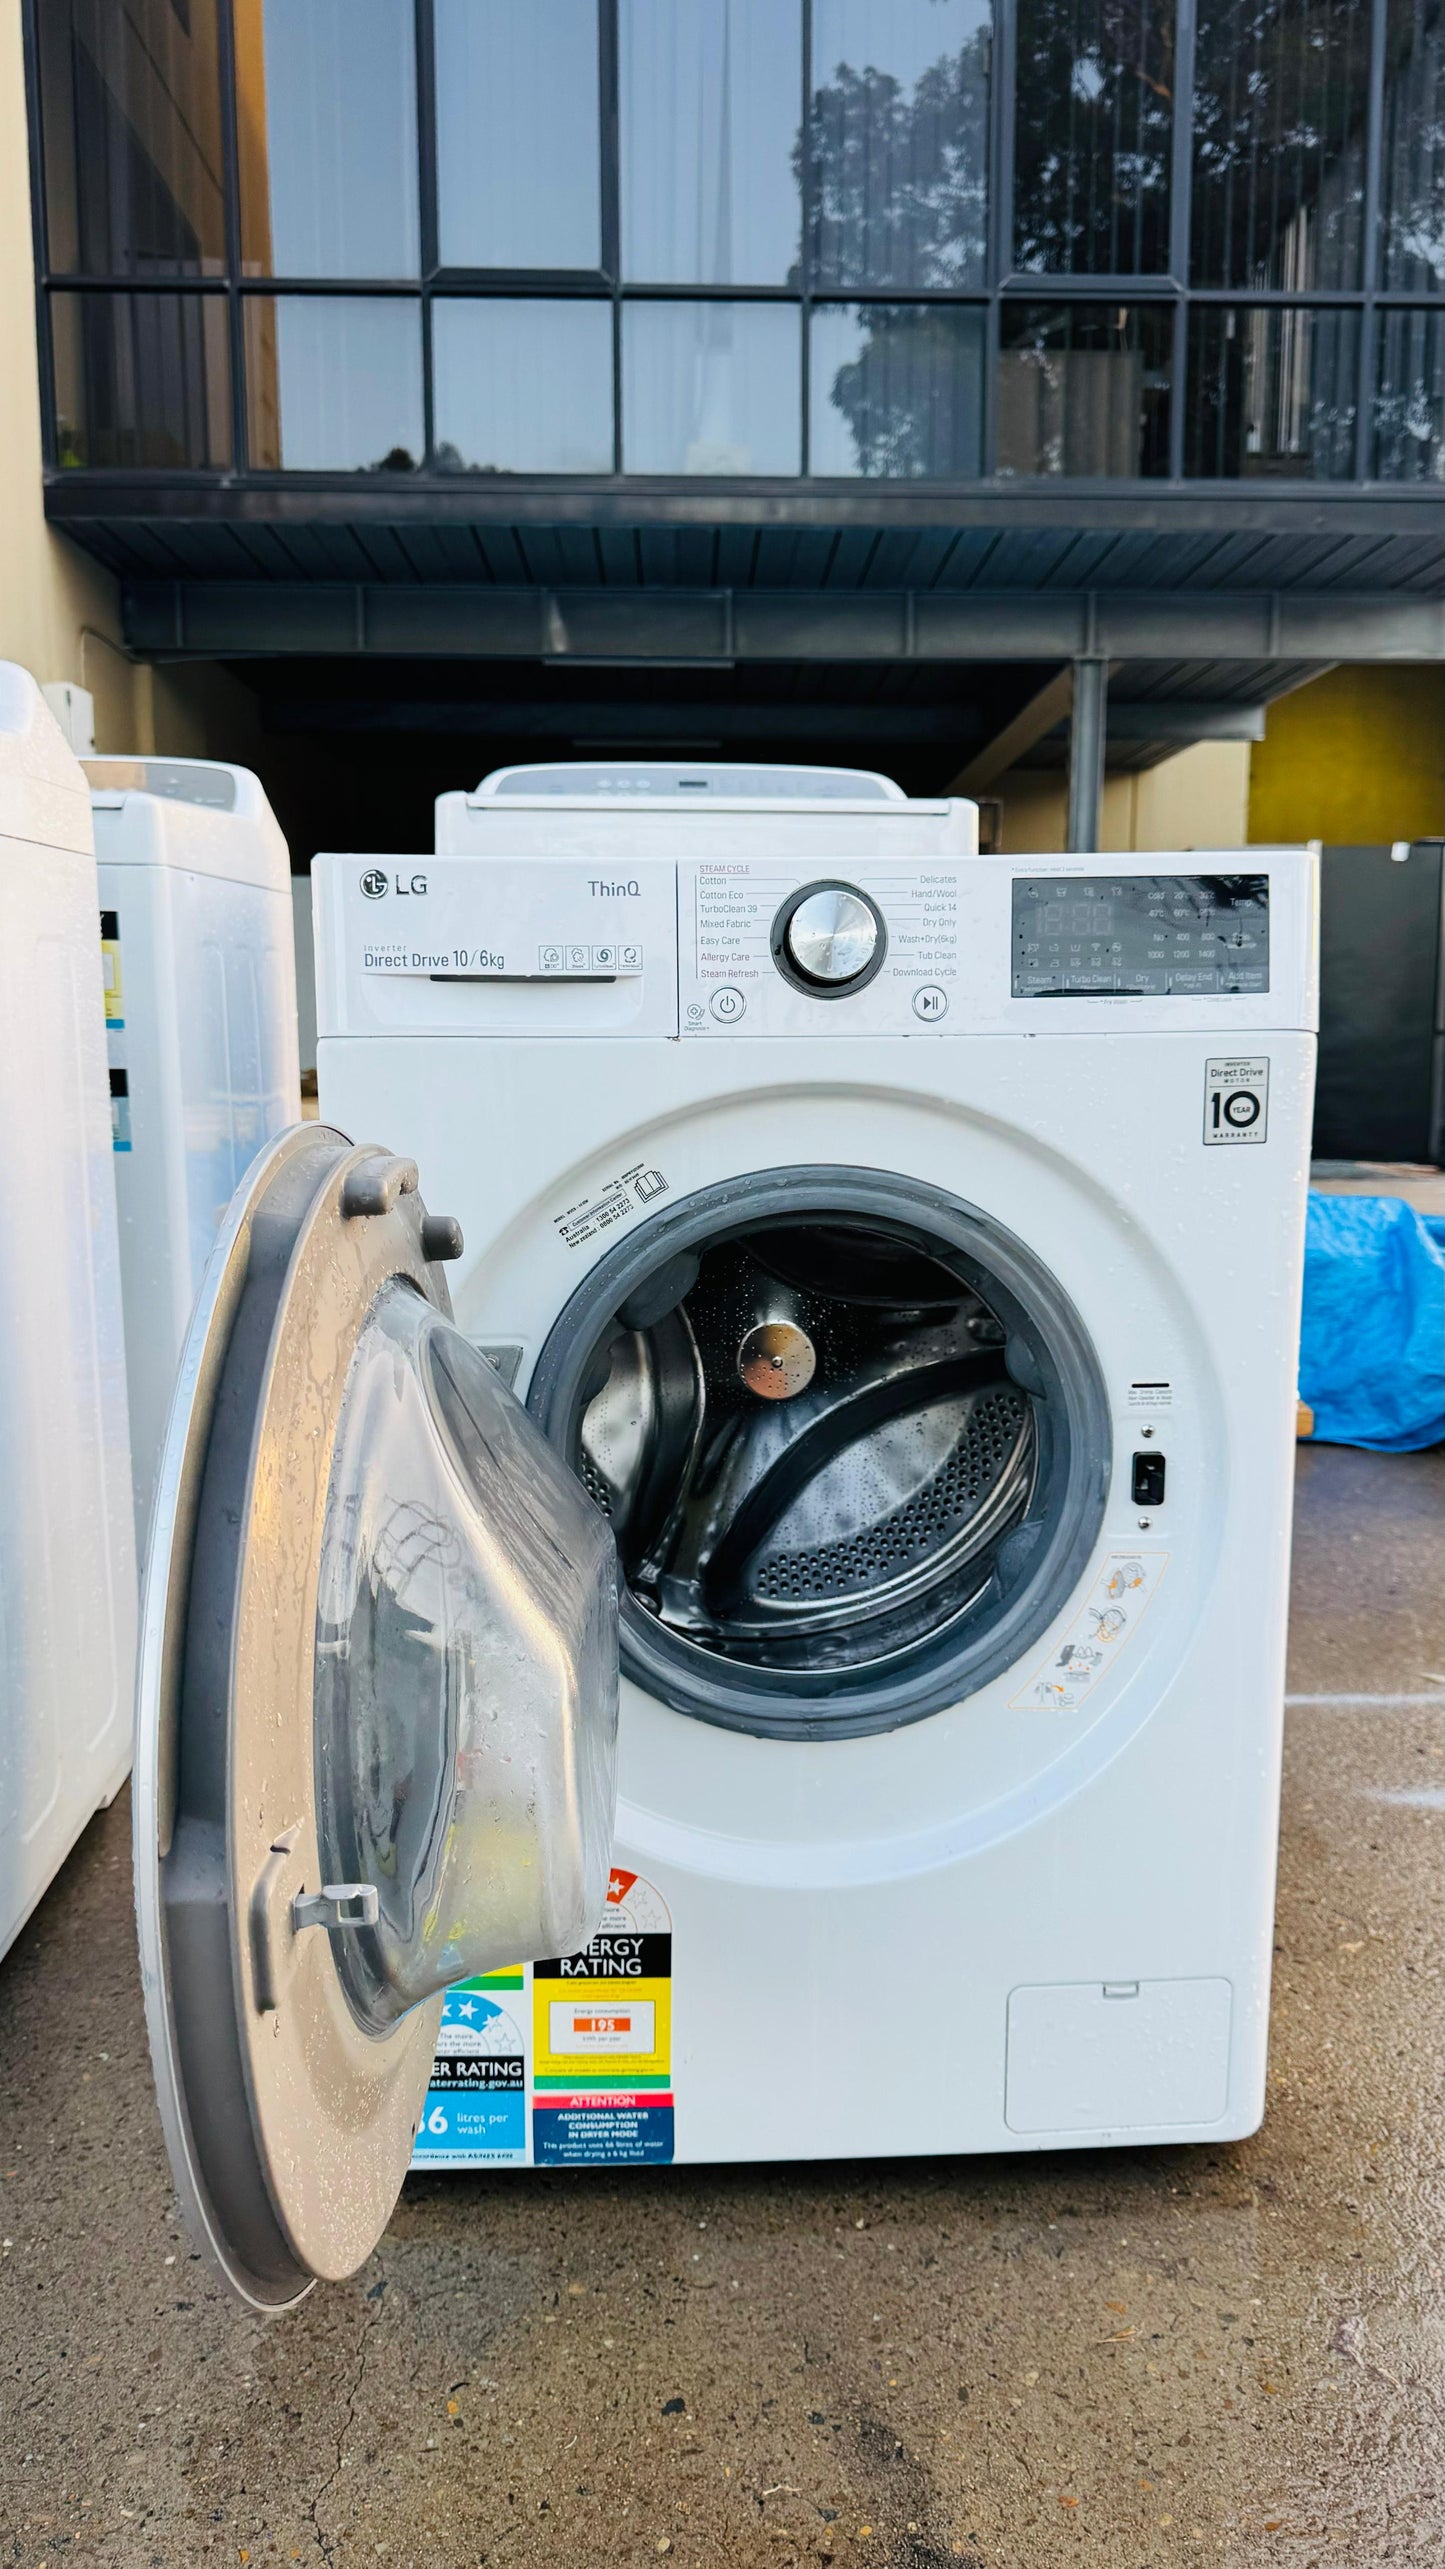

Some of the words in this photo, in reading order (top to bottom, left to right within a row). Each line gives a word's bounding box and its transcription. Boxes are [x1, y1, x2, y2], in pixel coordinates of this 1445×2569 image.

[699, 865, 726, 873] STEAM
[727, 865, 750, 873] CYCLE
[699, 876, 727, 885] Cotton
[920, 875, 957, 884] Delicates
[395, 874, 428, 895] LG
[588, 880, 641, 897] ThinQ
[700, 891, 727, 899] Cotton
[729, 891, 744, 899] Eco
[911, 890, 957, 898] Hand/Wool
[700, 905, 746, 913] TurboClean
[747, 905, 758, 913] 39
[924, 903, 947, 912] Quick
[948, 903, 957, 911] 14
[700, 920, 725, 928] Mixed
[726, 920, 751, 928] Fabric
[922, 918, 937, 927] Dry
[939, 918, 957, 928] Only
[701, 936, 720, 946] Easy
[721, 936, 740, 945] Care
[898, 935, 958, 944] Wash+Dry(6kg)
[364, 944, 407, 952] Inverter
[364, 953, 408, 967] Direct
[412, 953, 449, 967] Drive
[701, 953, 730, 963] Allergy
[731, 953, 750, 961] Care
[918, 951, 933, 960] Tub
[934, 951, 957, 960] Clean
[701, 970, 727, 978] Steam
[728, 970, 759, 978] Refresh
[893, 968, 933, 977] Download
[934, 967, 957, 978] Cycle
[1135, 975, 1150, 984] Dry
[1210, 1069, 1237, 1077] Direct
[1240, 1068, 1263, 1077] Drive
[1211, 1091, 1260, 1128] 10
[565, 1224, 590, 1242] Australia
[560, 1958, 642, 1976] RATING
[591, 2018, 615, 2031] 195
[456, 2061, 522, 2077] RATING
[570, 2095, 636, 2107] ATTENTION
[456, 2112, 486, 2123] litres
[489, 2115, 508, 2125] per
[557, 2112, 615, 2120] ADDITIONAL
[616, 2111, 649, 2120] WATER
[457, 2124, 486, 2135] wash
[568, 2121, 638, 2130] CONSUMPTION
[568, 2131, 579, 2139] IN
[580, 2130, 610, 2138] DRYER
[611, 2130, 638, 2138] MODE
[583, 2149, 605, 2158] drying
